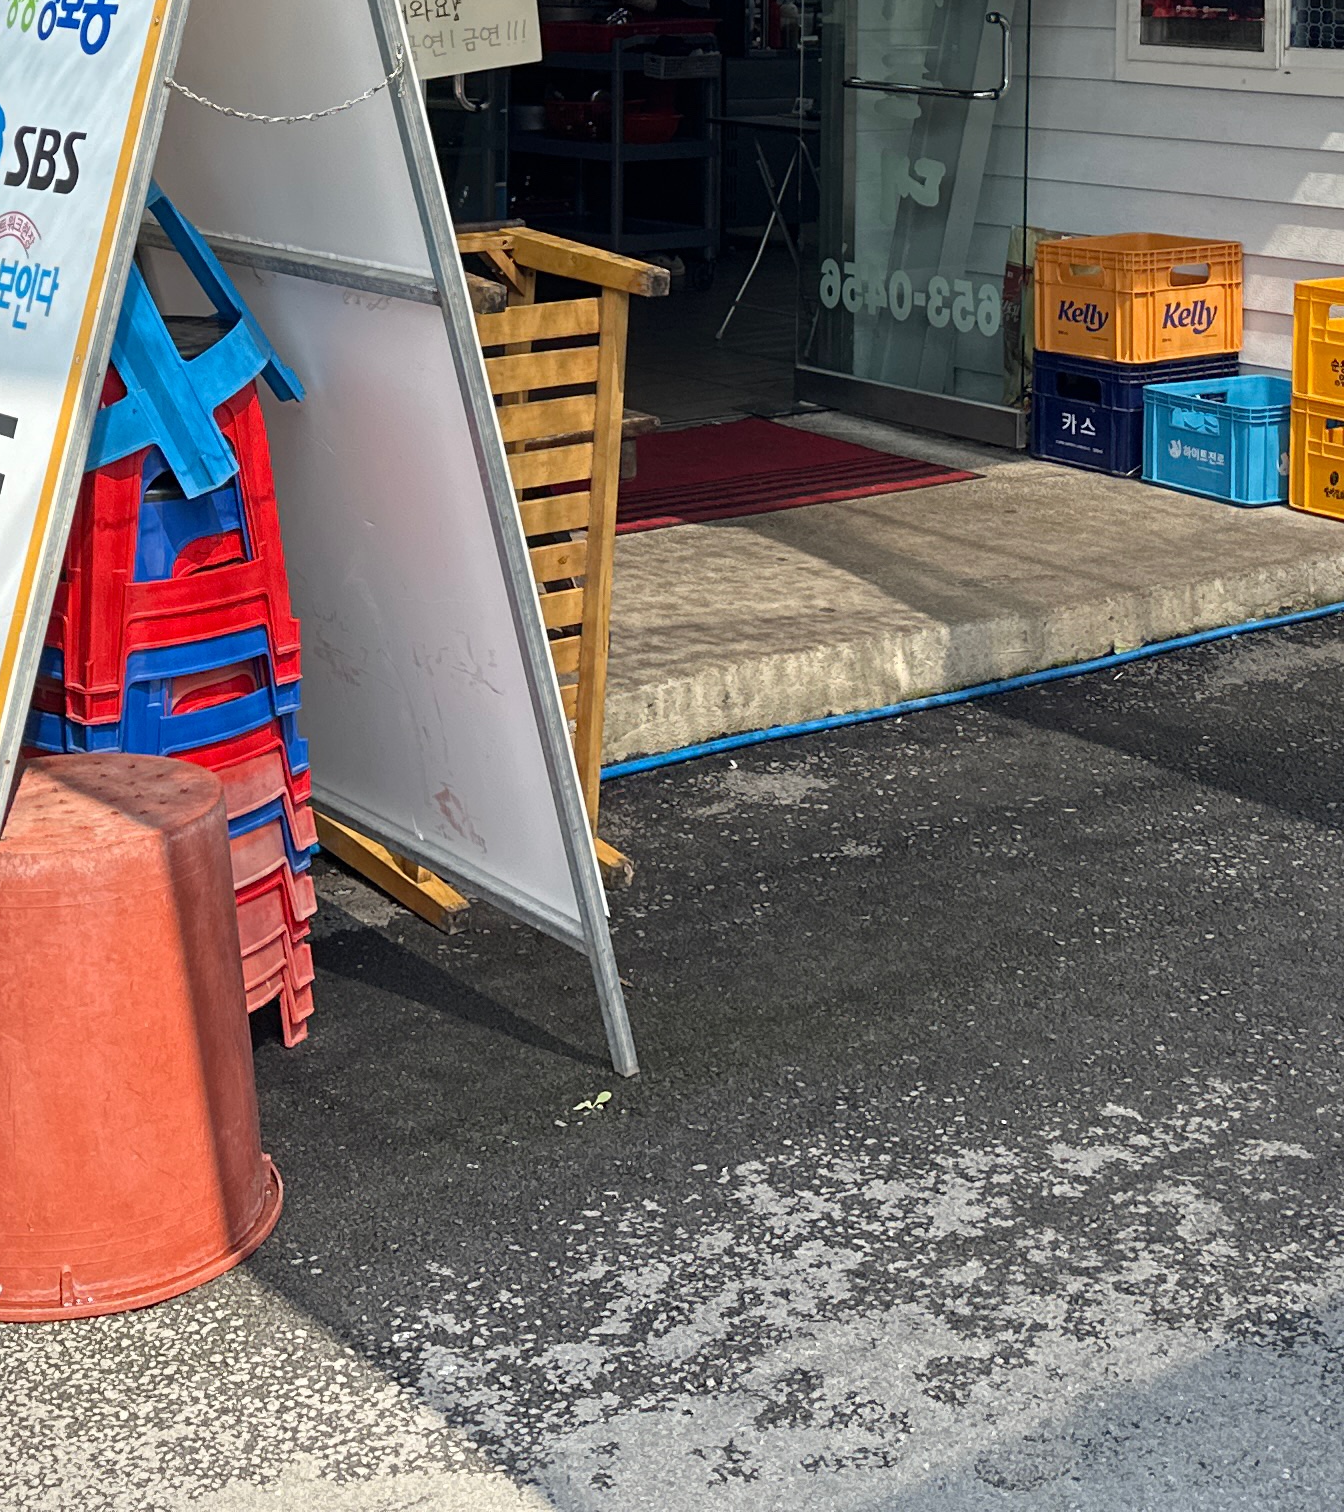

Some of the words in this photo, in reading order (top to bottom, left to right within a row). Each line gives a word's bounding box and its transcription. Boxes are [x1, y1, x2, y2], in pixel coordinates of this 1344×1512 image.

[4, 123, 88, 195] SBS
[1057, 299, 1110, 333] Kelly
[1161, 298, 1218, 335] Kelly
[1061, 411, 1097, 437] 카스
[1182, 444, 1226, 467] 하이트진로
